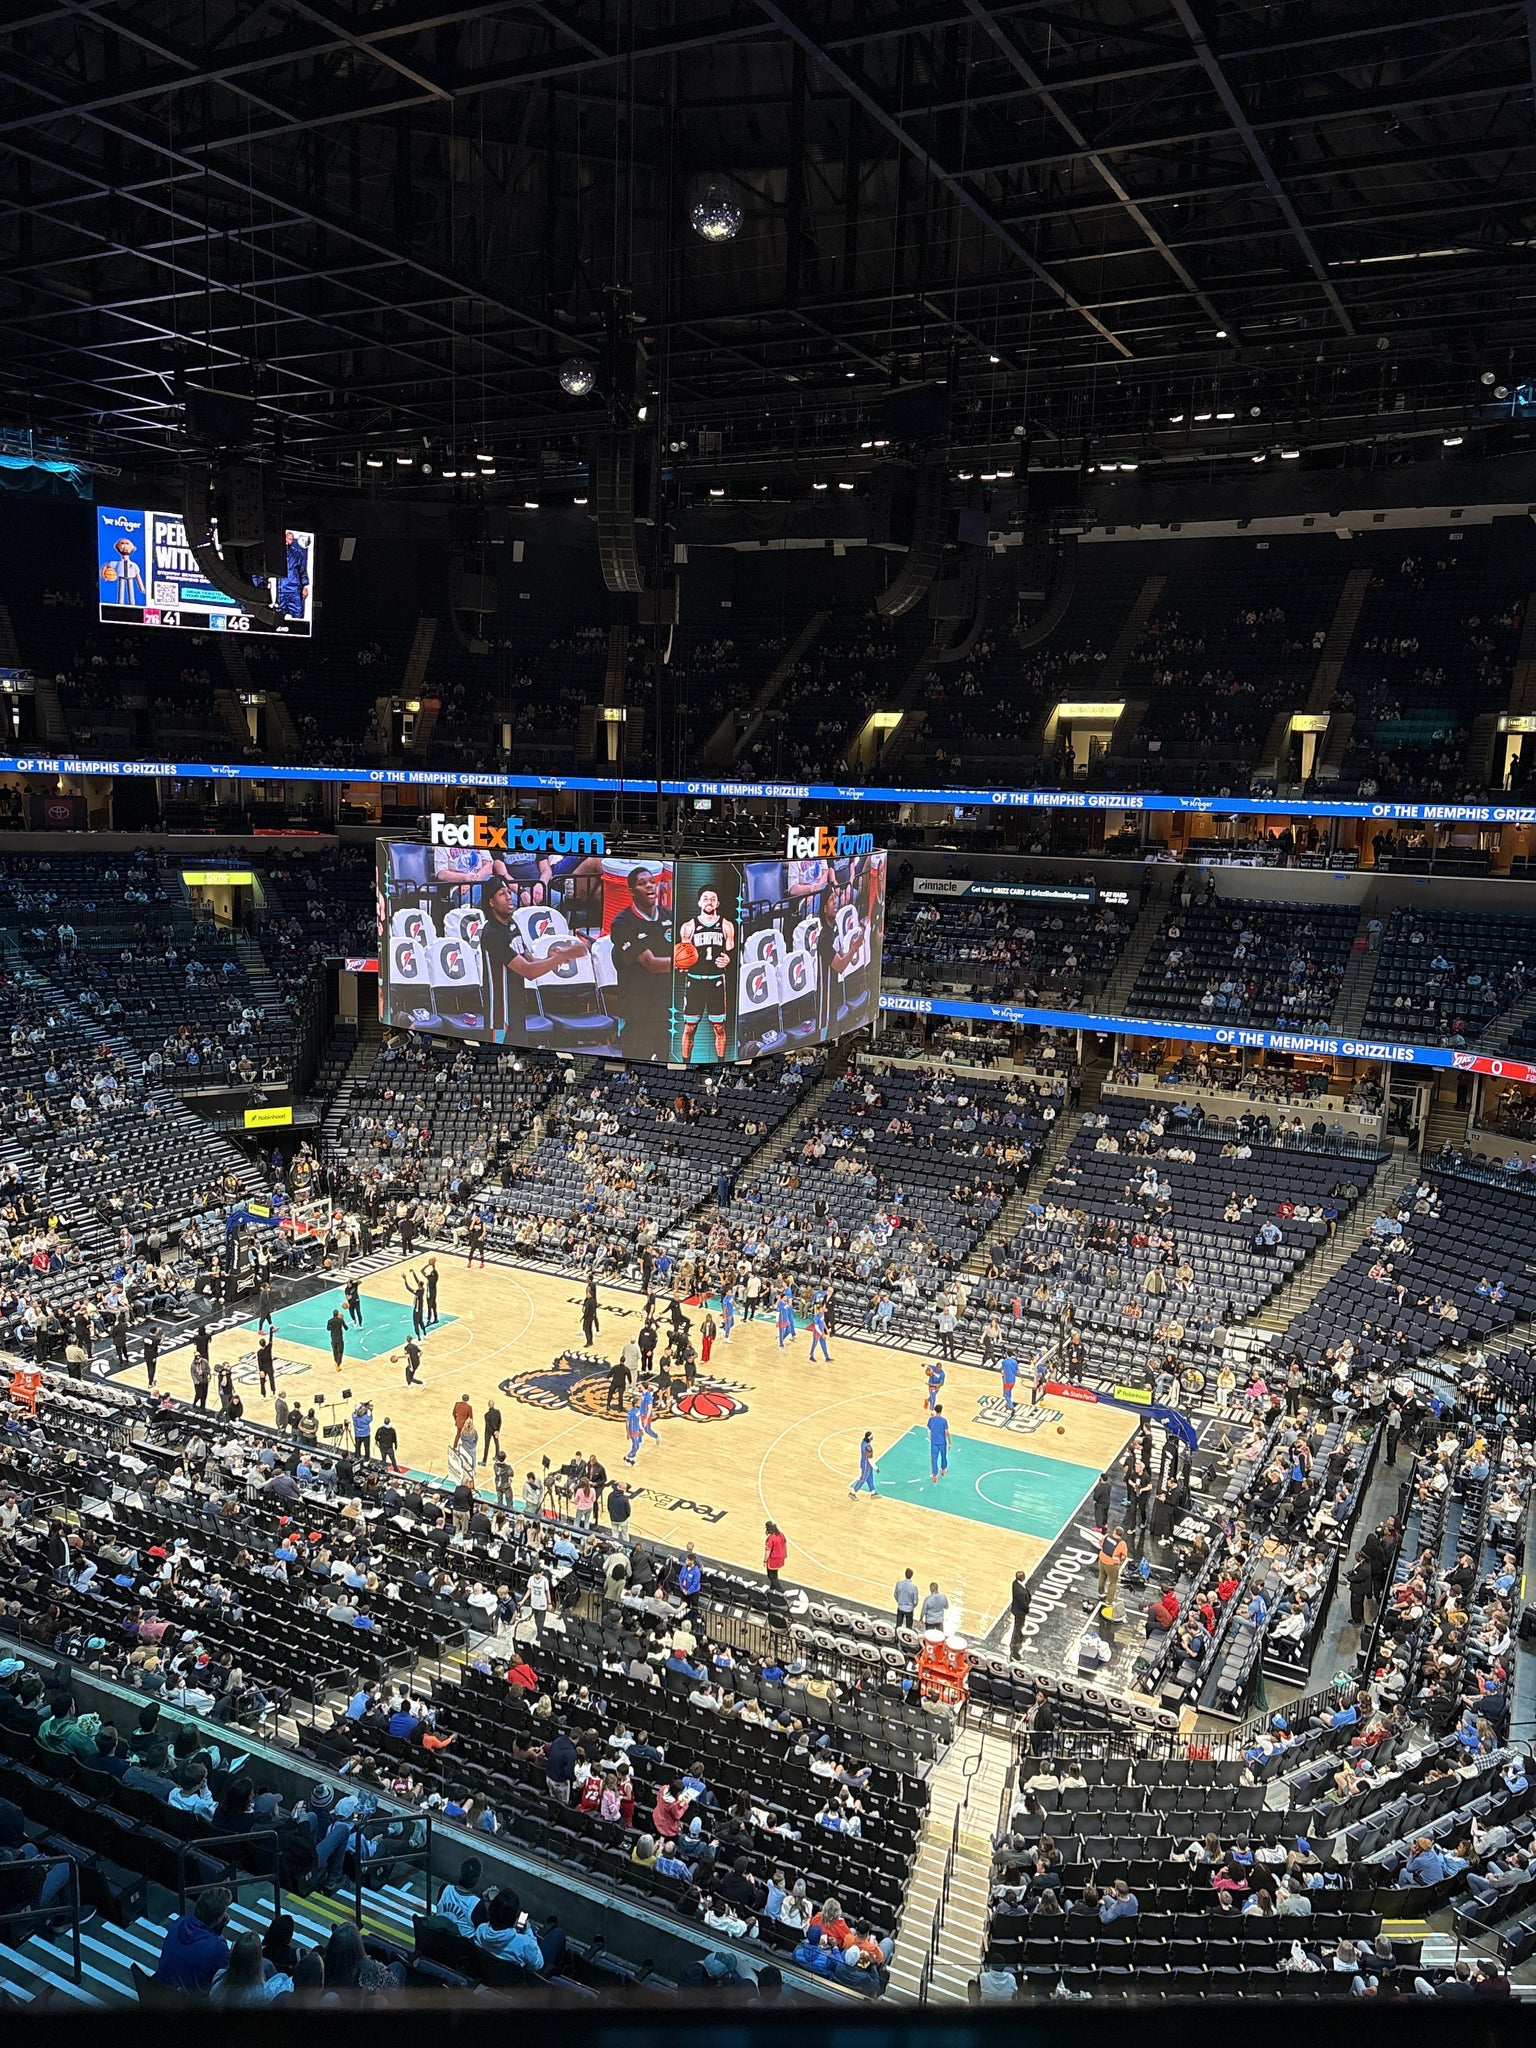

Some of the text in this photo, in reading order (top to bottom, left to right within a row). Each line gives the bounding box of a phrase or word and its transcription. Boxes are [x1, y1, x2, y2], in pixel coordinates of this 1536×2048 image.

[115, 516, 141, 532] Kroger
[163, 611, 181, 625] 41
[228, 616, 250, 631] 46
[17, 760, 177, 775] OF THE MEMPHIS GRIZZLIES
[220, 765, 240, 777] Kroger
[370, 771, 508, 785] OF THE MEMPHIS GRIZZLIES
[688, 783, 809, 797] OF THE MEMPHIS GRIZZLIES
[992, 793, 1143, 807] OF THE MEMPHIS GRIZZLIES
[1189, 797, 1213, 811] Kroger
[1372, 804, 1392, 816] OF
[1394, 805, 1418, 817] THE
[1423, 806, 1489, 819] MEMPHIS
[431, 812, 605, 854] FedExForum
[787, 825, 873, 858] FedExForum
[918, 879, 957, 892] Pinnacle
[981, 886, 992, 894] Your
[993, 887, 1009, 895] GRIZZ
[1010, 888, 1025, 896] CARD
[404, 914, 427, 948] G
[693, 931, 724, 947] MEMPHIS
[705, 946, 713, 960] 1
[395, 942, 419, 979] G
[440, 941, 466, 980] G
[788, 953, 808, 992] G
[745, 965, 769, 1004] G
[879, 996, 932, 1012] GRIZZLIES
[1001, 1007, 1024, 1022] Kroger
[1216, 1030, 1414, 1061] OF THE MEMPHIS GRIZZLIES
[1491, 1060, 1503, 1075] 0
[258, 1113, 286, 1121] Robinhood
[1180, 1516, 1211, 1534] Auto
[926, 1645, 934, 1654] G
[948, 1652, 956, 1661] G
[969, 1654, 979, 1665] G
[991, 1662, 1002, 1672] G
[1014, 1668, 1025, 1679] G
[1037, 1676, 1050, 1686] G
[1062, 1682, 1074, 1692] G
[1086, 1689, 1098, 1699] G
[1110, 1698, 1122, 1708] G
[1134, 1706, 1146, 1716] G
[1158, 1714, 1171, 1725] G
